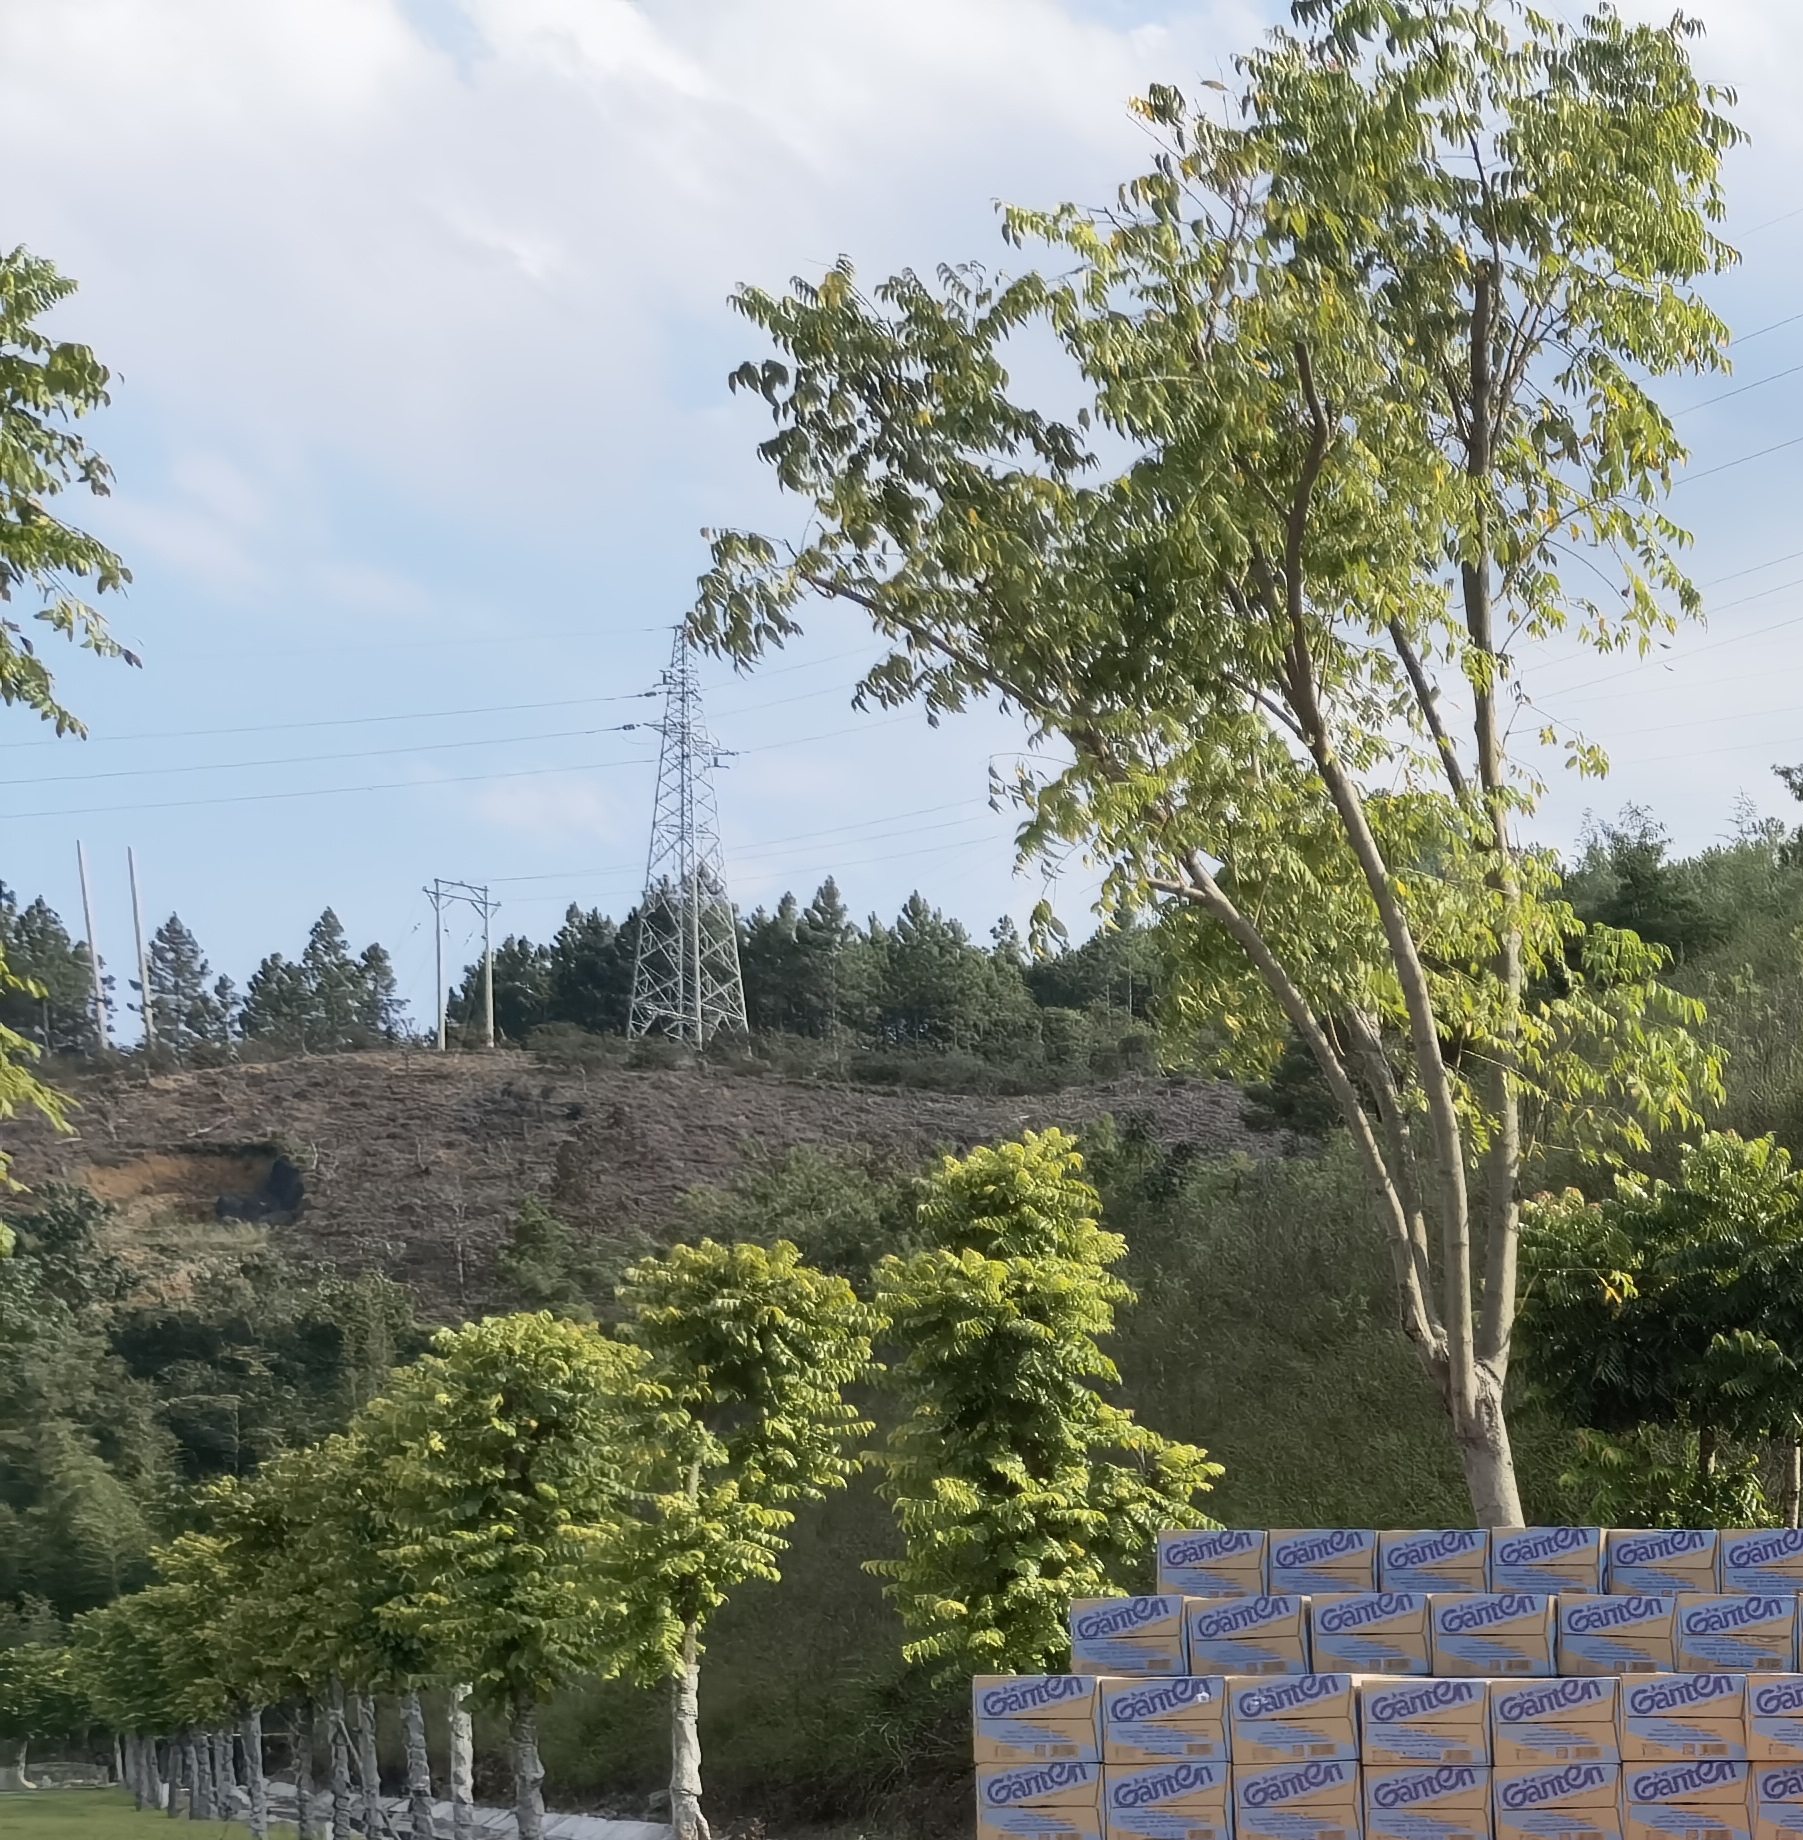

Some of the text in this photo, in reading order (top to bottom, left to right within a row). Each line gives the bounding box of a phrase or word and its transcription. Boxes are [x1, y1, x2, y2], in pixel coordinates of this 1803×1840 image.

[1164, 1531, 1255, 1571] Ganten
[1489, 1528, 1590, 1568] Ganten
[1614, 1530, 1706, 1566] Ganten
[1077, 1597, 1171, 1642] Ganten
[1197, 1593, 1291, 1639] Ganten
[1320, 1591, 1415, 1634] Ganten
[1441, 1589, 1538, 1635] Ganten
[1567, 1595, 1665, 1638] Ganten
[983, 1677, 1085, 1717] Ganten
[1371, 1680, 1475, 1724] Ganten
[1499, 1679, 1602, 1721] Ganten
[987, 1761, 1088, 1806] Ganten
[1113, 1763, 1214, 1809] Ganten
[1243, 1759, 1344, 1809] Ganten
[1374, 1765, 1477, 1810] Ganten
[1633, 1759, 1738, 1803] Ganten
